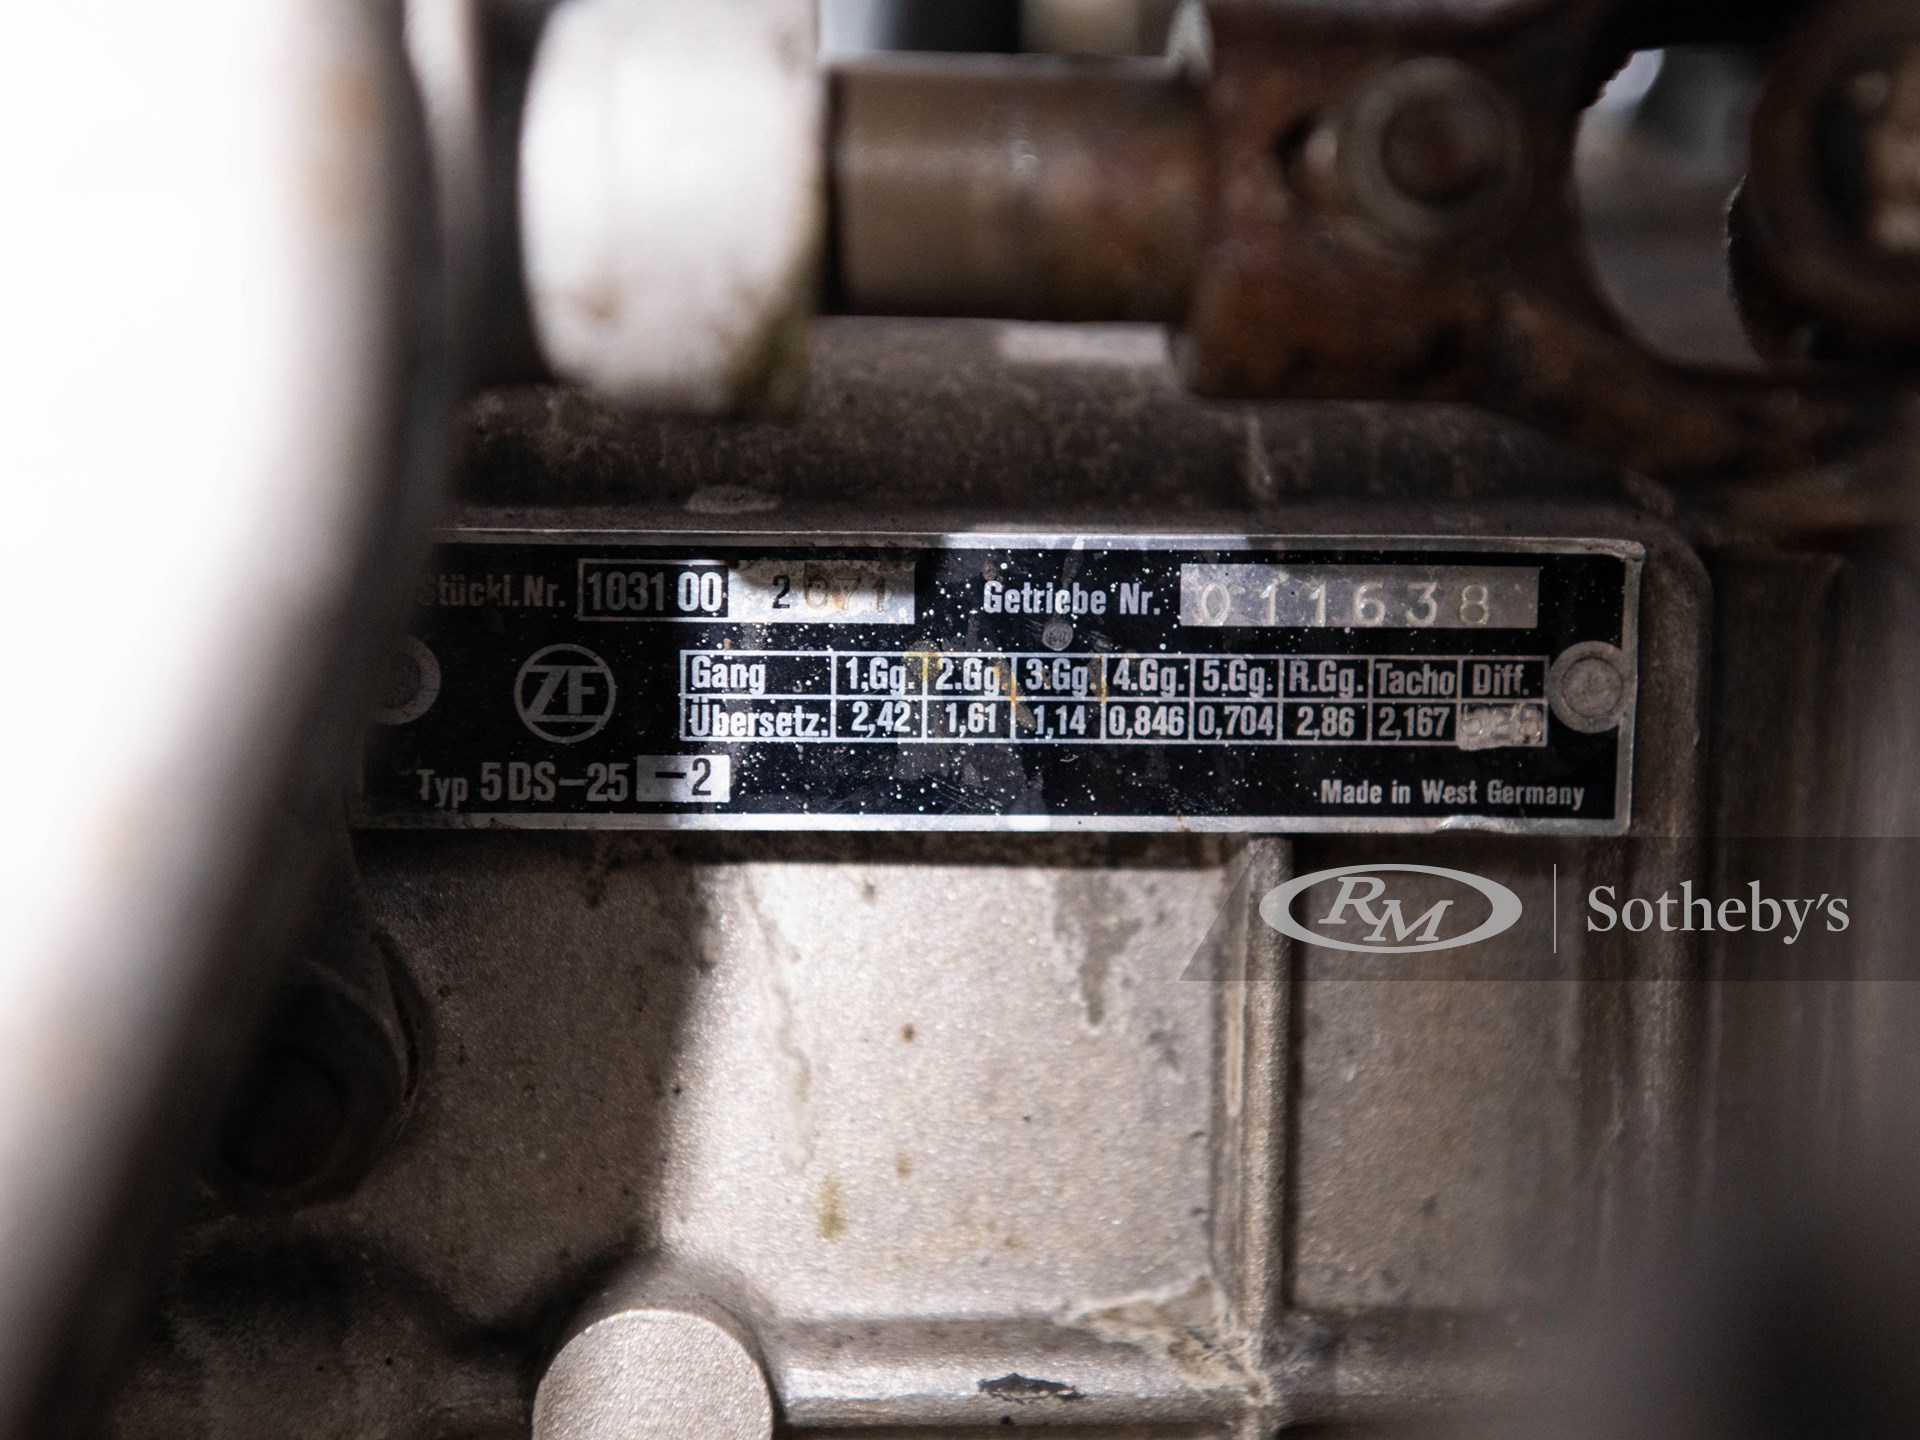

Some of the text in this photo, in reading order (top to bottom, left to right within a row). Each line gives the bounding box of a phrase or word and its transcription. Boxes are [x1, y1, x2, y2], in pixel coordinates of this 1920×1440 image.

[418, 574, 566, 607] tückl.Nr.
[587, 571, 664, 611] 1031
[677, 571, 723, 612] 00
[983, 580, 1490, 627] Getriebe Nr. 011638
[690, 655, 767, 694] Gang
[935, 657, 1009, 697] 2.Gg.
[1112, 658, 1186, 698] 4.Gg.
[1202, 659, 1275, 698] 5.Gg.
[1289, 660, 1364, 698] R.Gg.
[1376, 662, 1456, 696] Tacho
[1473, 664, 1530, 696] Diff.
[690, 697, 830, 738] Übersetz.
[851, 701, 912, 738] 2,42
[945, 702, 998, 739] 1,61
[1033, 705, 1087, 740] 1,14
[1108, 705, 1186, 741] 0,846
[1198, 705, 1275, 741] 0,704
[1296, 705, 1356, 742] 2,86
[1378, 706, 1451, 742] 2,167
[416, 769, 469, 809] Typ
[1320, 779, 1586, 811] Made in West Germany
